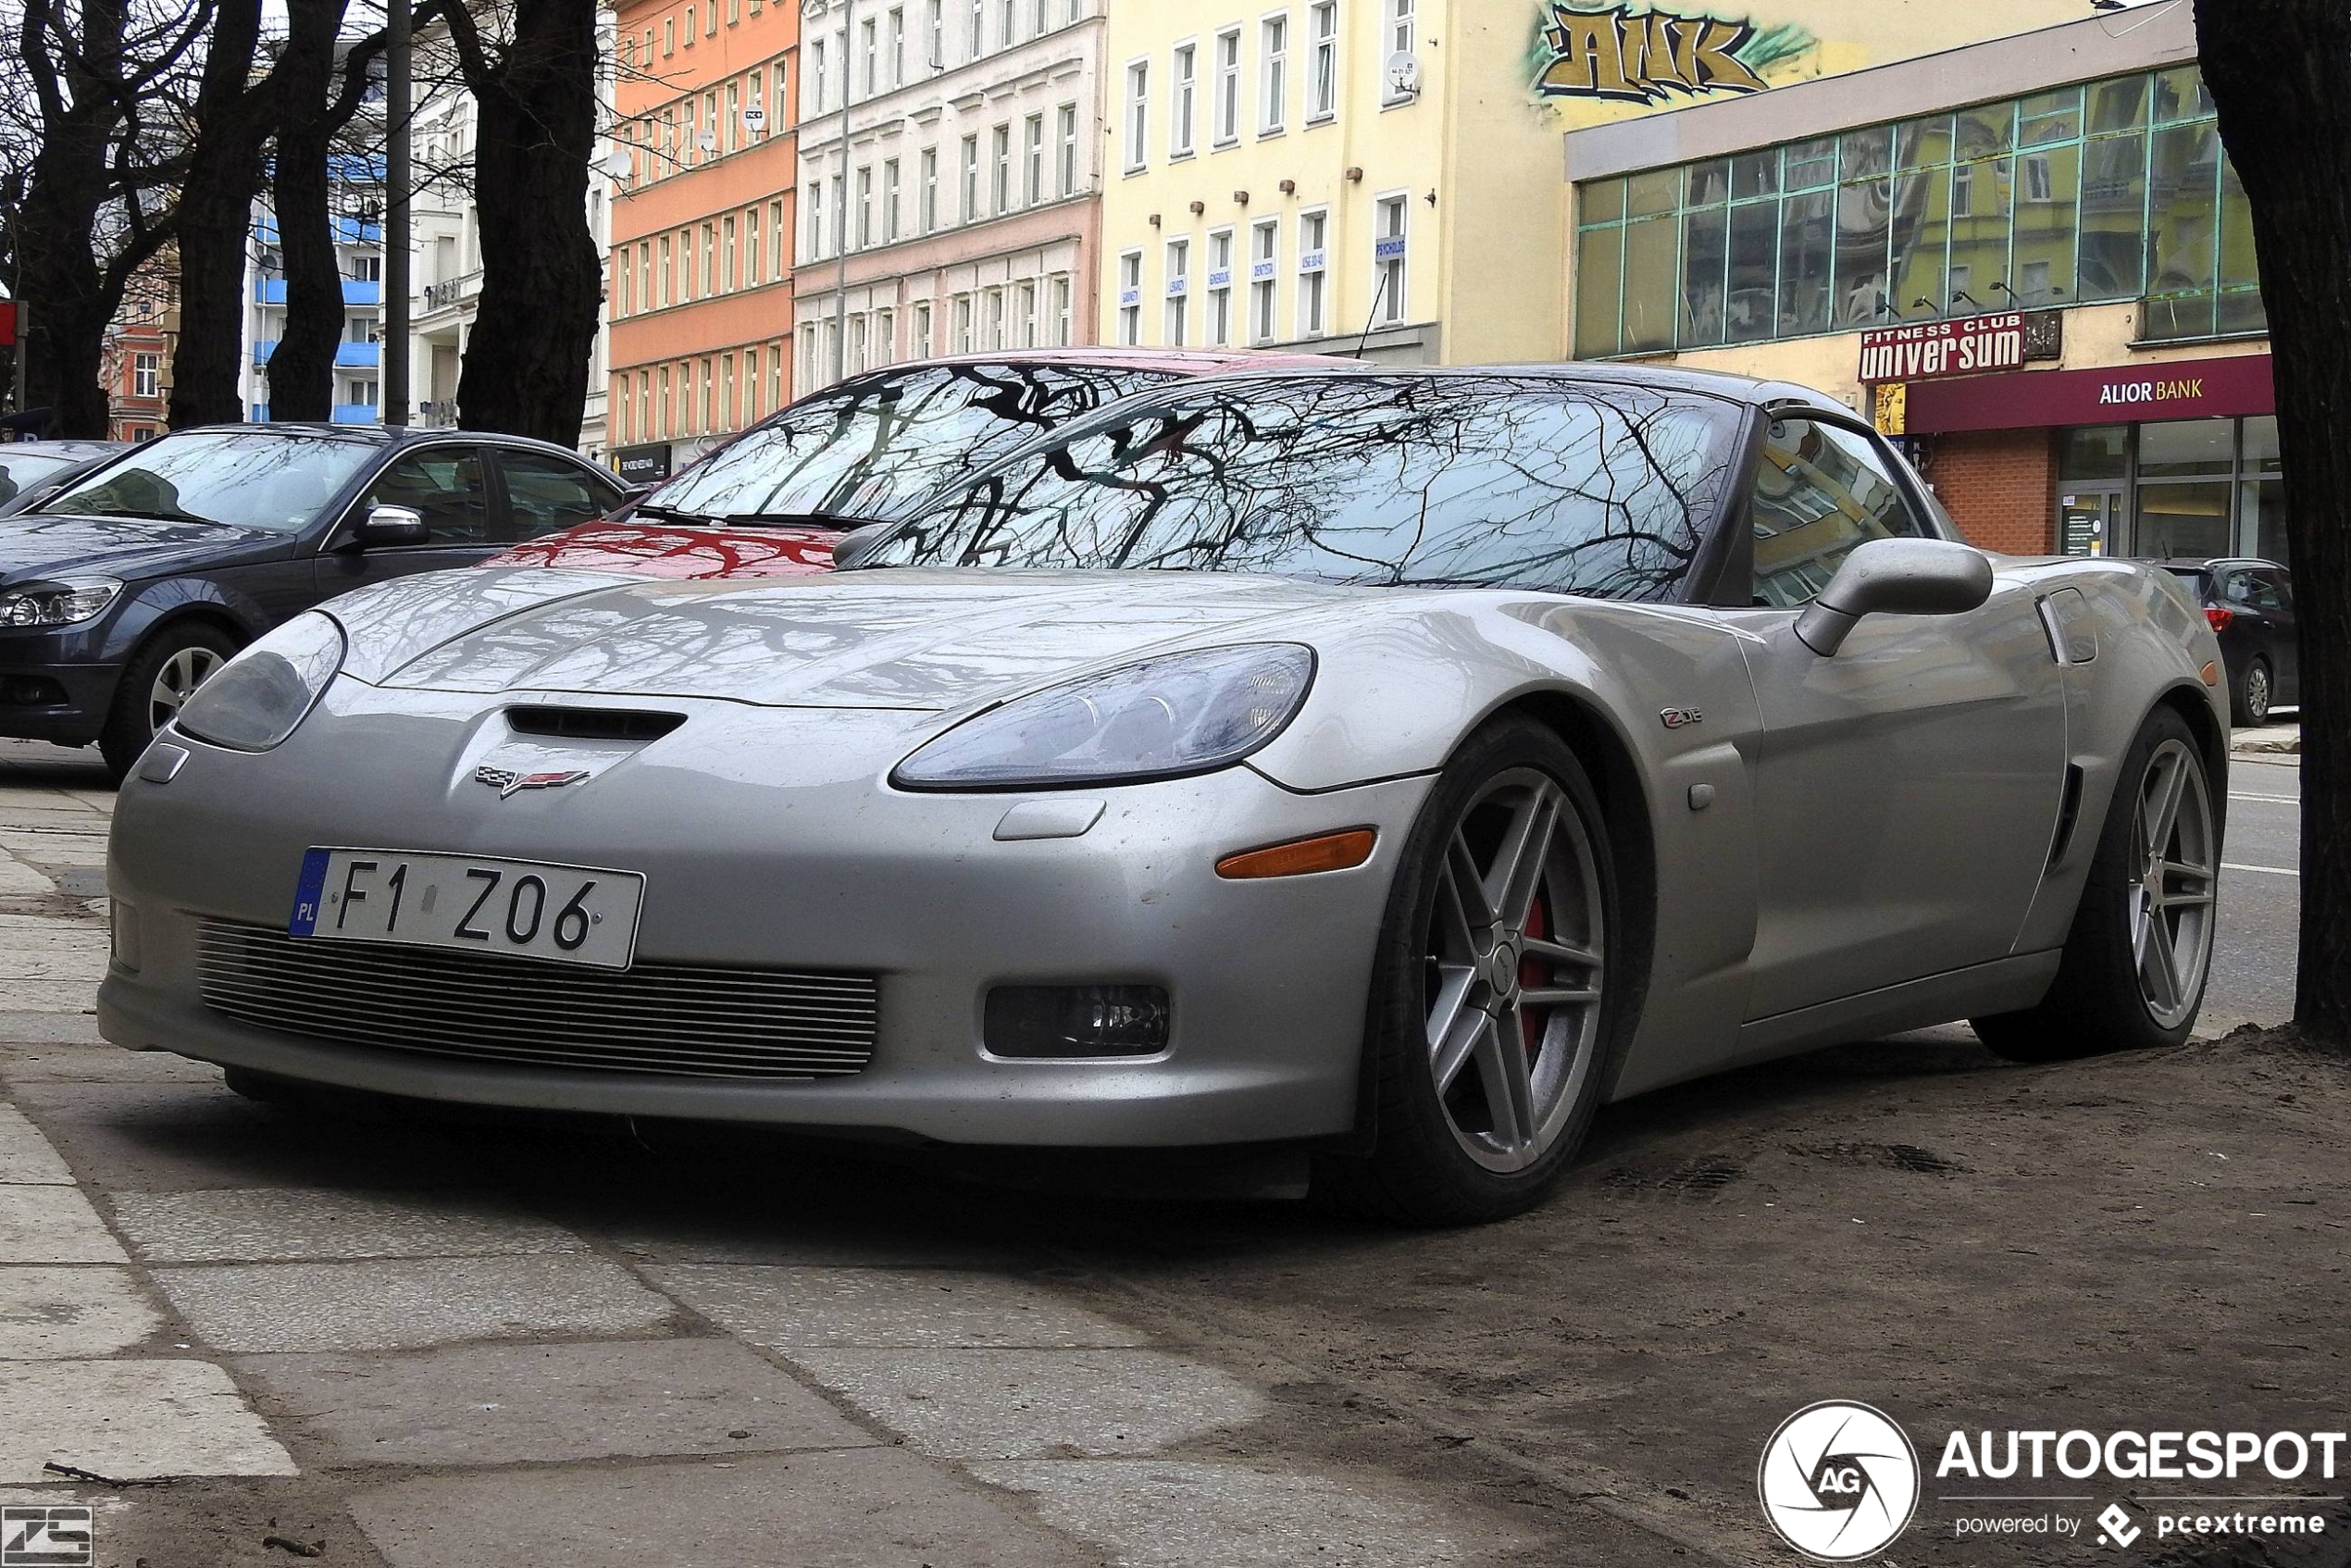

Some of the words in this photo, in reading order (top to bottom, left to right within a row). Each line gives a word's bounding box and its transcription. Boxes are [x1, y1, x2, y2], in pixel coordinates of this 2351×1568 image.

[1863, 323, 1952, 344] FITNESS
[1963, 315, 2021, 331] CLUB
[2099, 381, 2153, 404] ALIOR
[2156, 379, 2203, 401] BANK
[297, 902, 315, 923] PL
[336, 860, 408, 933] F1
[454, 867, 598, 951] Z06
